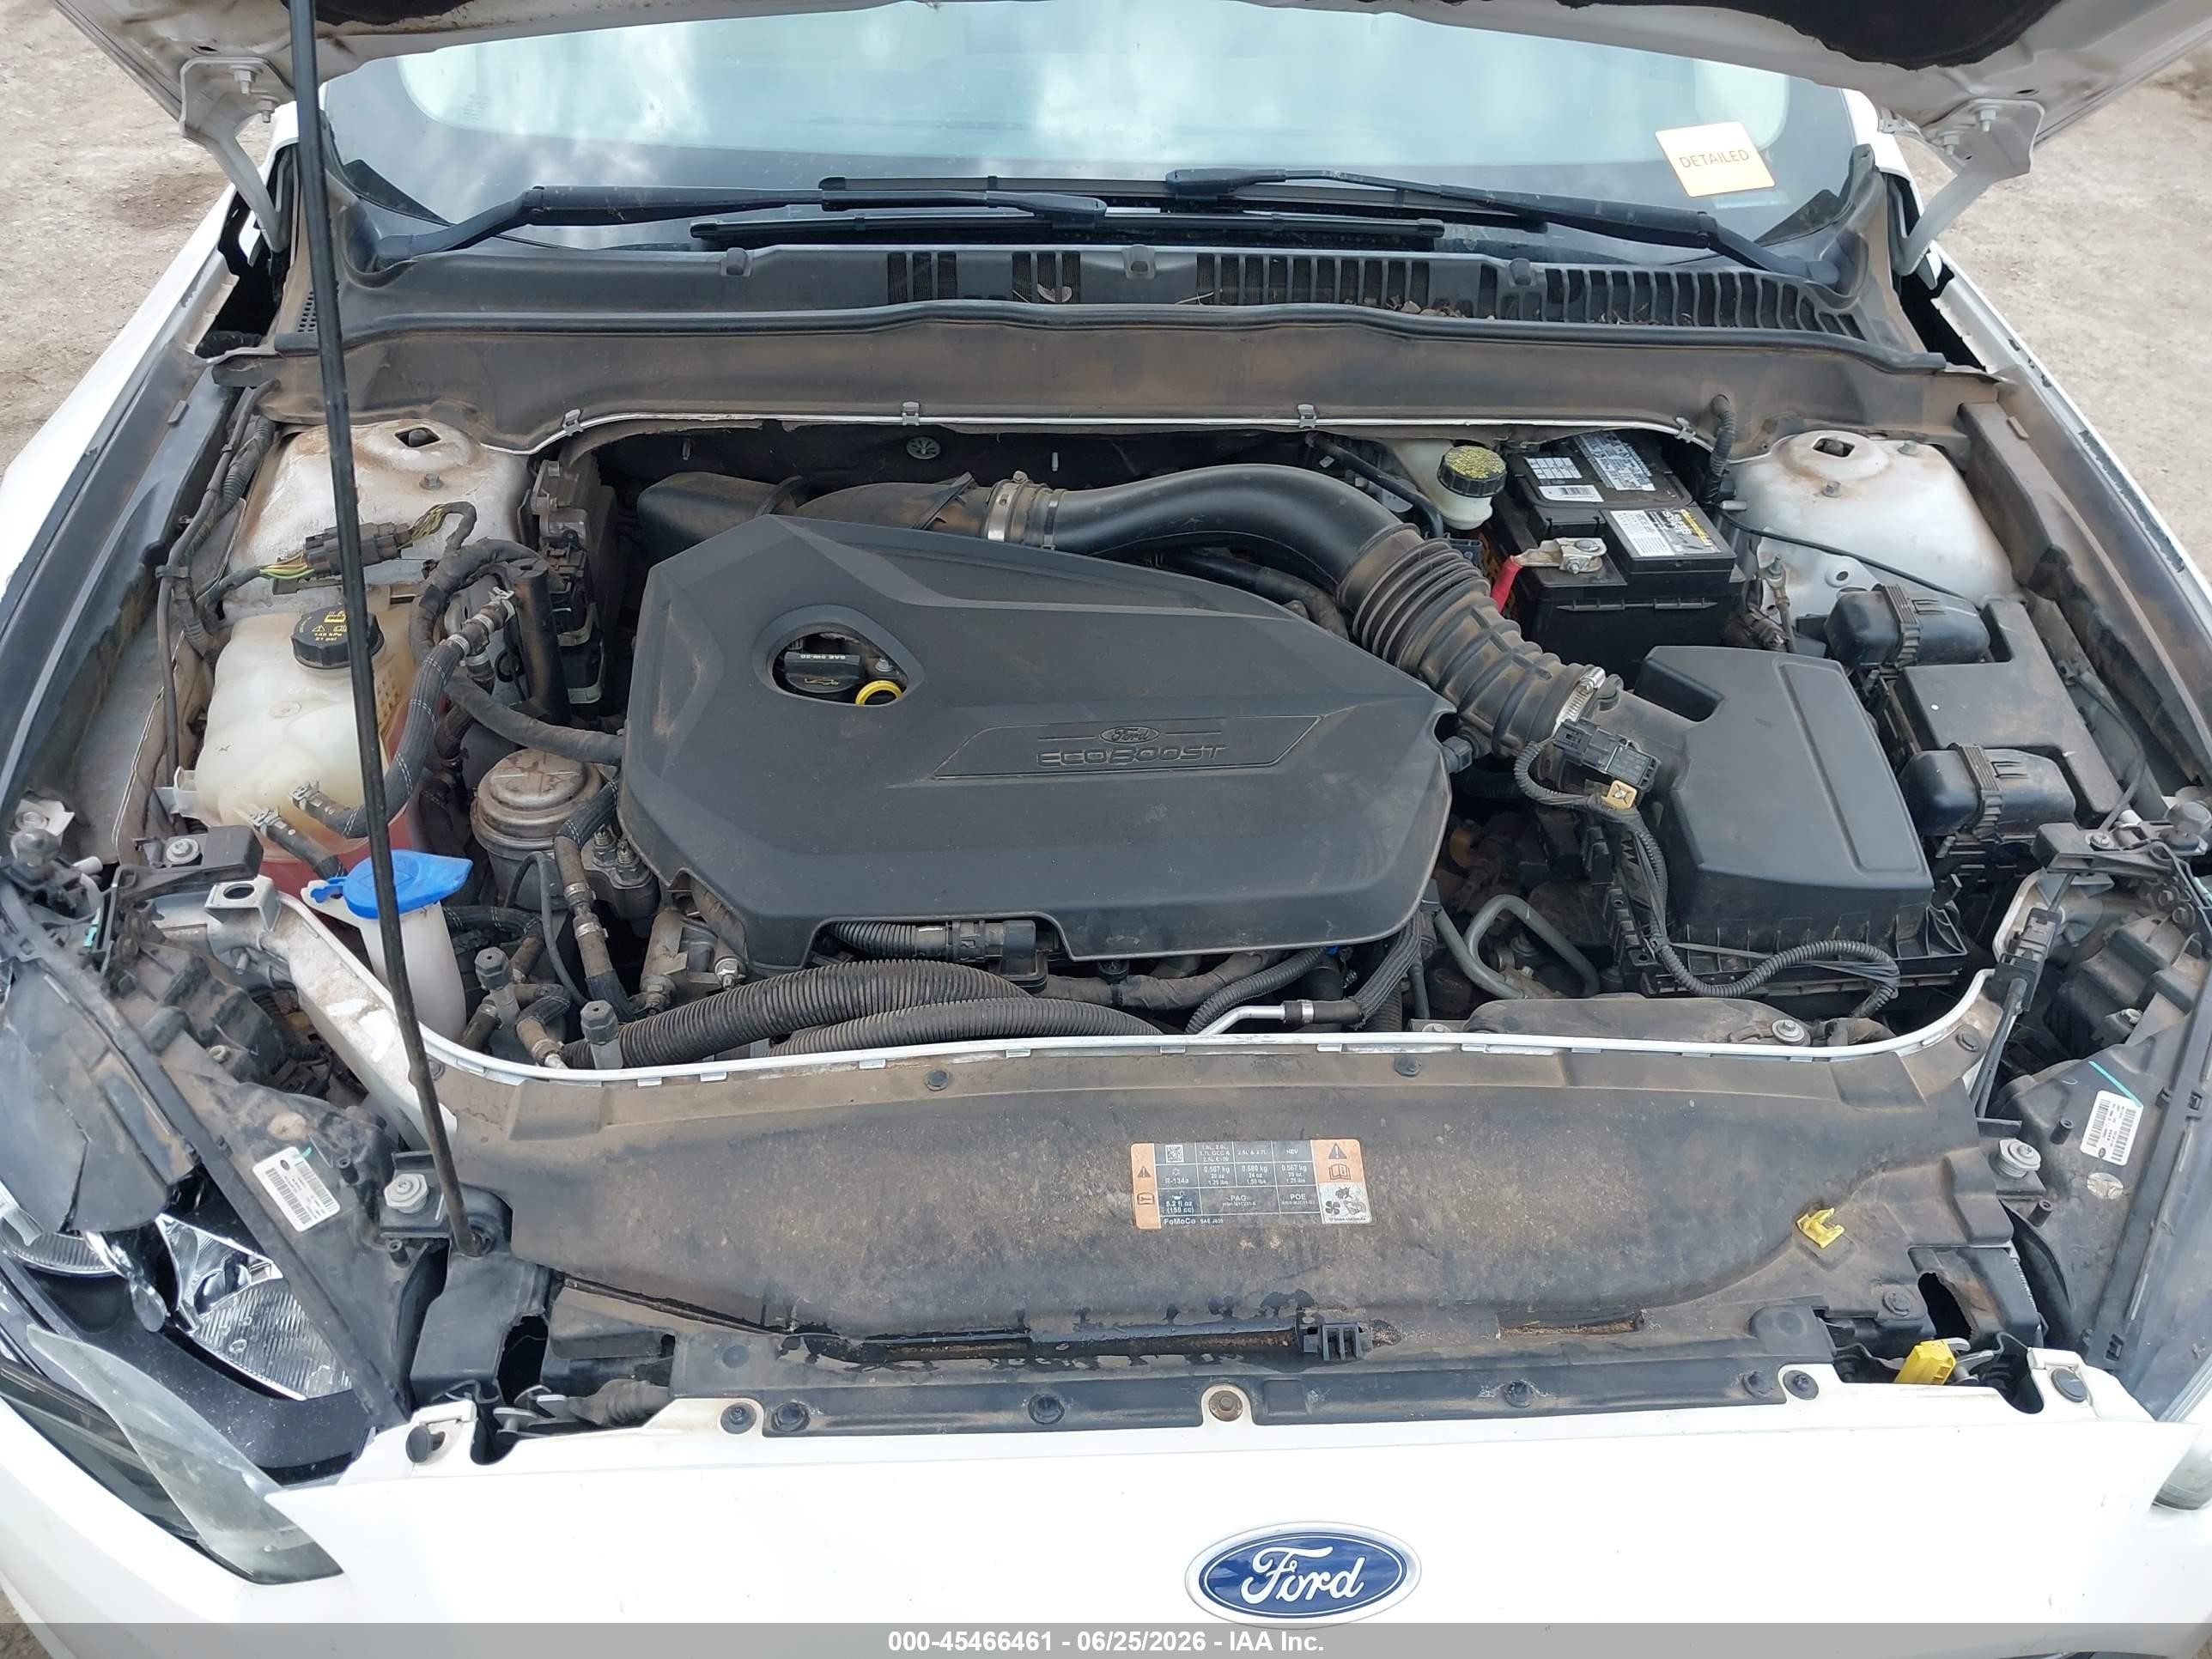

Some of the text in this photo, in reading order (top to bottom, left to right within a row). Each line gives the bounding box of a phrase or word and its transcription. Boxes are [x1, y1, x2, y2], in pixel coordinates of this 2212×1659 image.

[1679, 149, 1750, 168] DETAILED
[1111, 728, 1149, 742] Ford
[1260, 1164, 1268, 1173] kg
[1241, 1546, 1366, 1604] Ford
